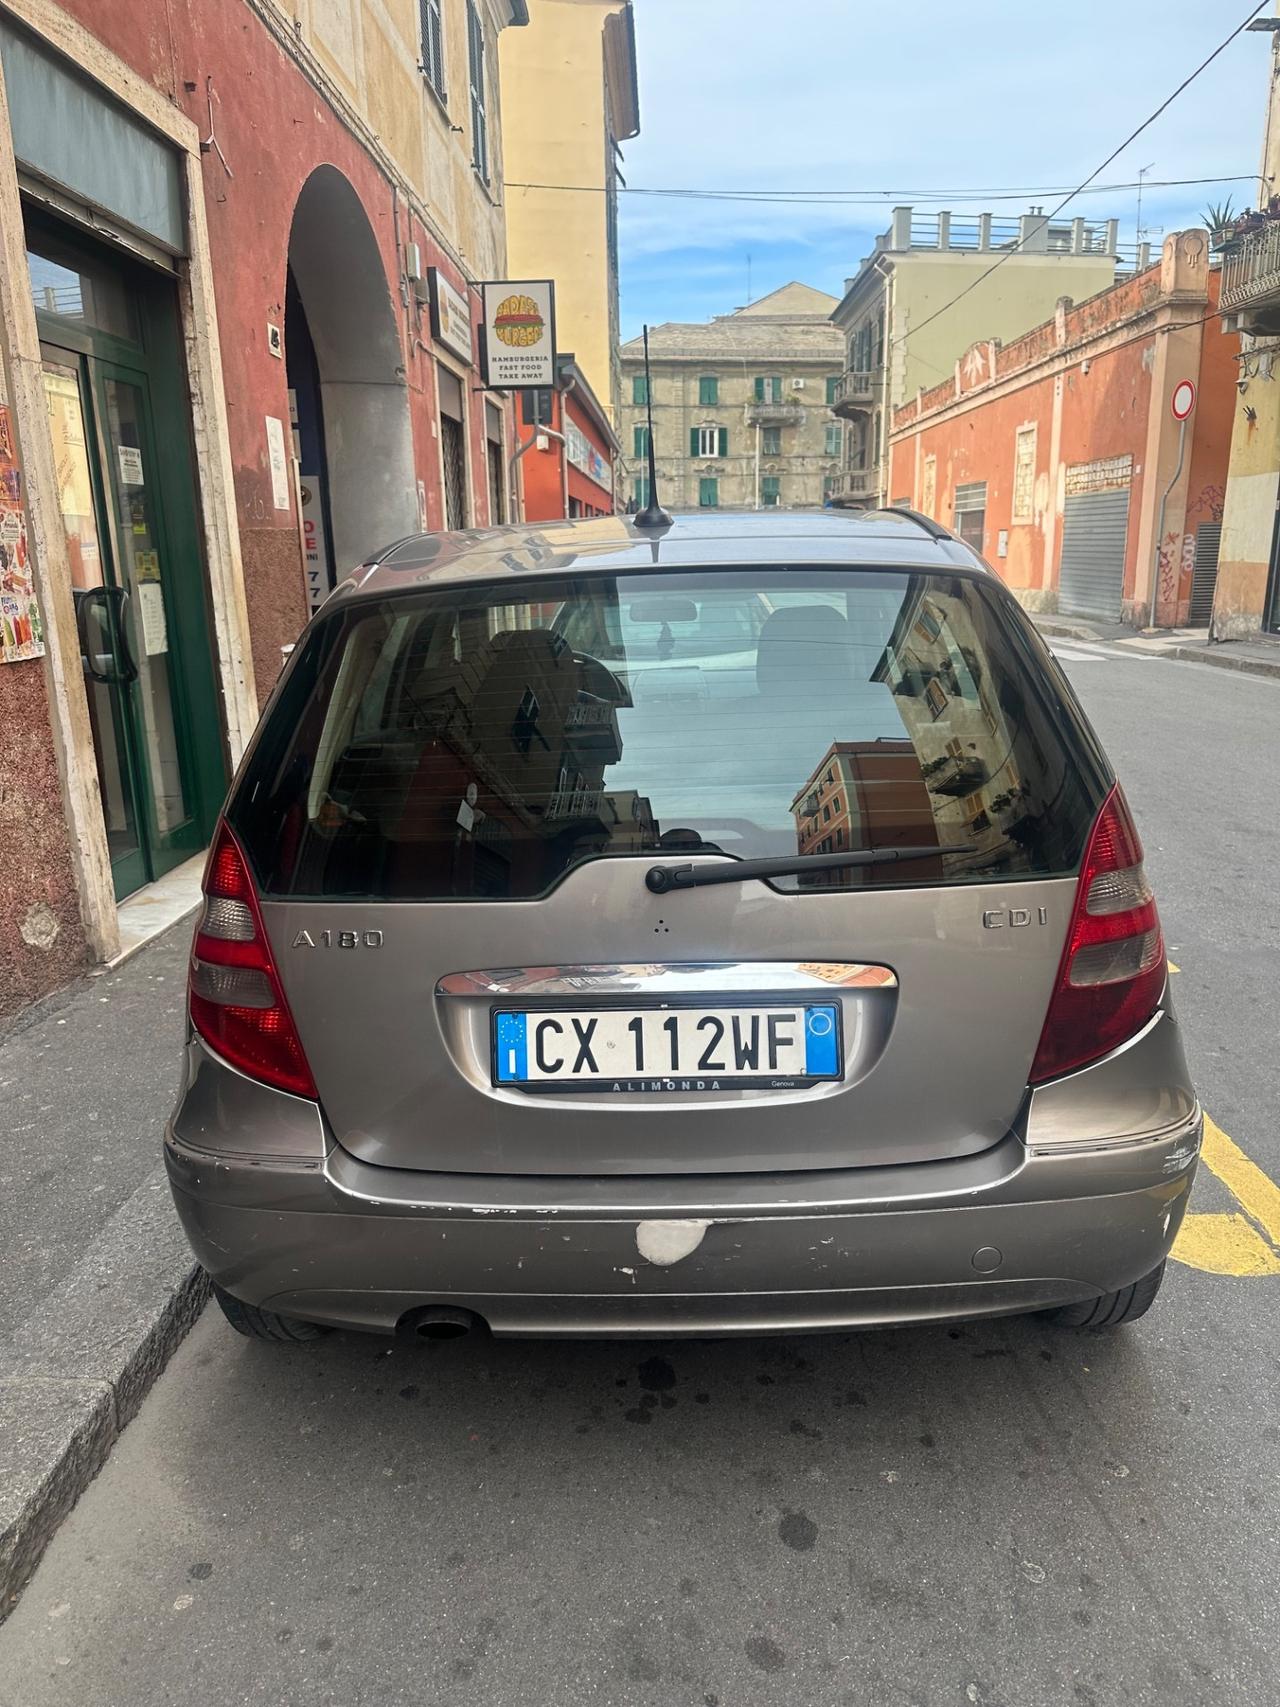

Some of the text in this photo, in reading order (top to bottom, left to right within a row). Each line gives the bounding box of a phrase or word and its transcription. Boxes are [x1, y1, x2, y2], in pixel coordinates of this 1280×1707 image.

[492, 355, 549, 363] HAMBURGERIA
[982, 906, 1047, 929] CDI
[291, 929, 385, 949] A180
[535, 1017, 600, 1074] CX
[613, 1079, 795, 1092] ALIMONDA Genova
